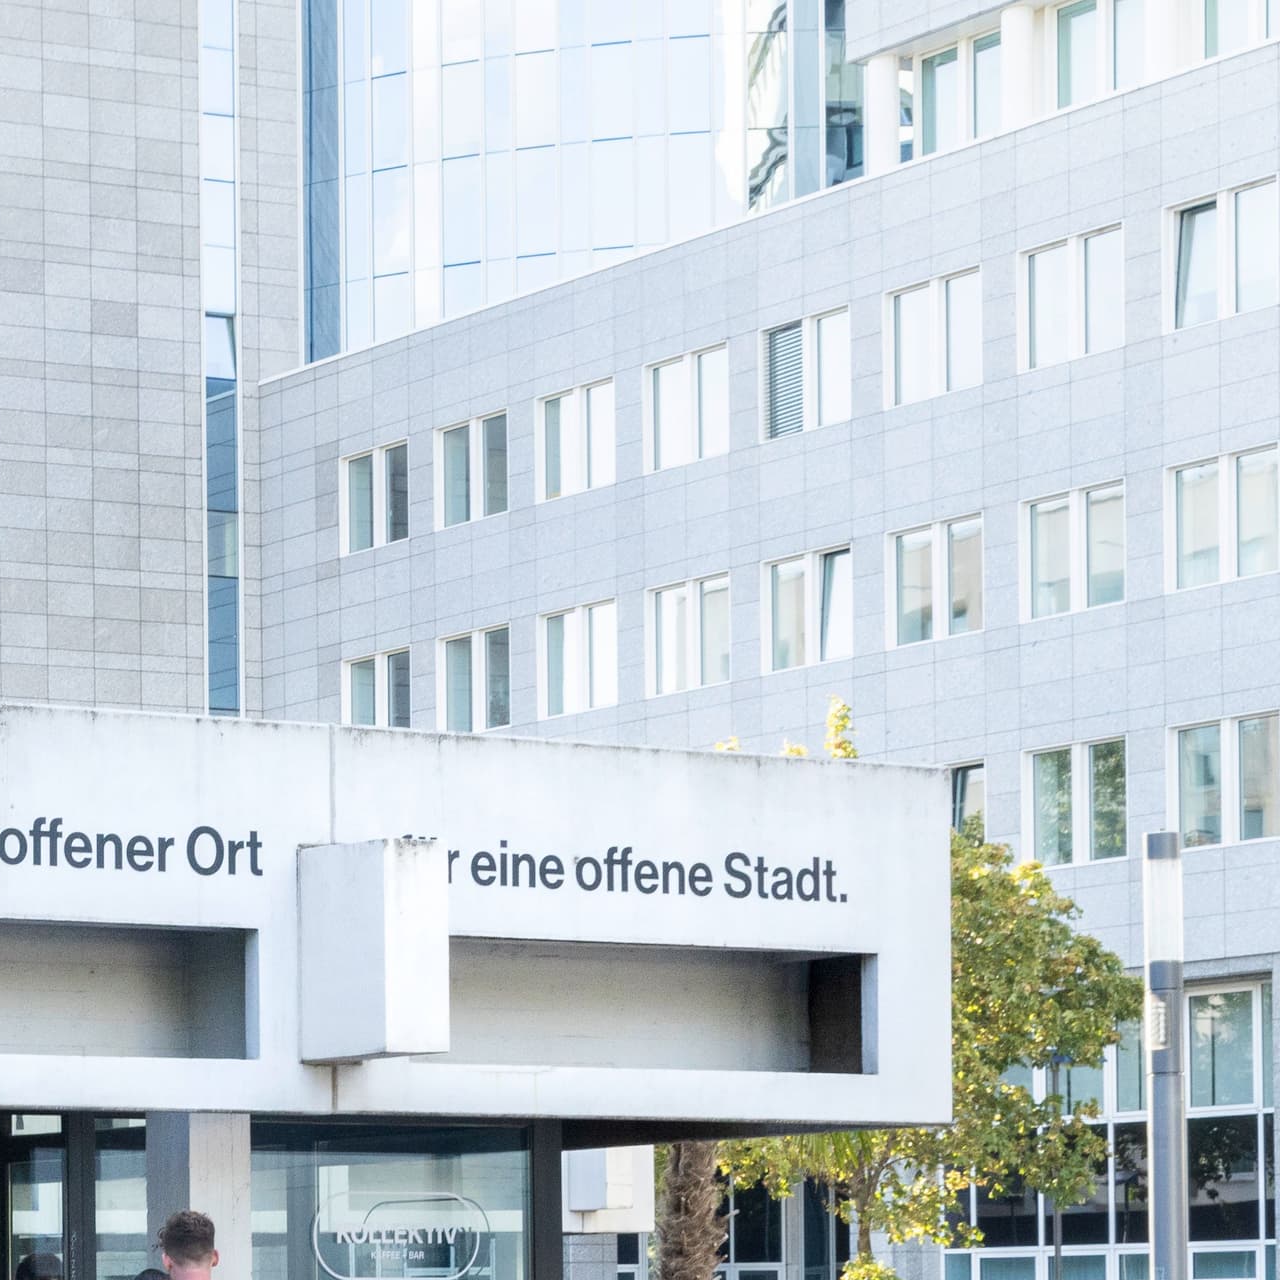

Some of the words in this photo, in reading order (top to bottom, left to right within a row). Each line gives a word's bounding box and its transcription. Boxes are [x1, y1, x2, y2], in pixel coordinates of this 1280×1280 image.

[186, 826, 263, 876] Ort
[471, 839, 565, 889] eine
[575, 846, 713, 897] offene
[724, 853, 847, 903] Stadt.
[336, 1223, 457, 1244] KOLLEKTIV
[371, 1251, 400, 1260] KFFEE
[408, 1250, 425, 1260] BAR
